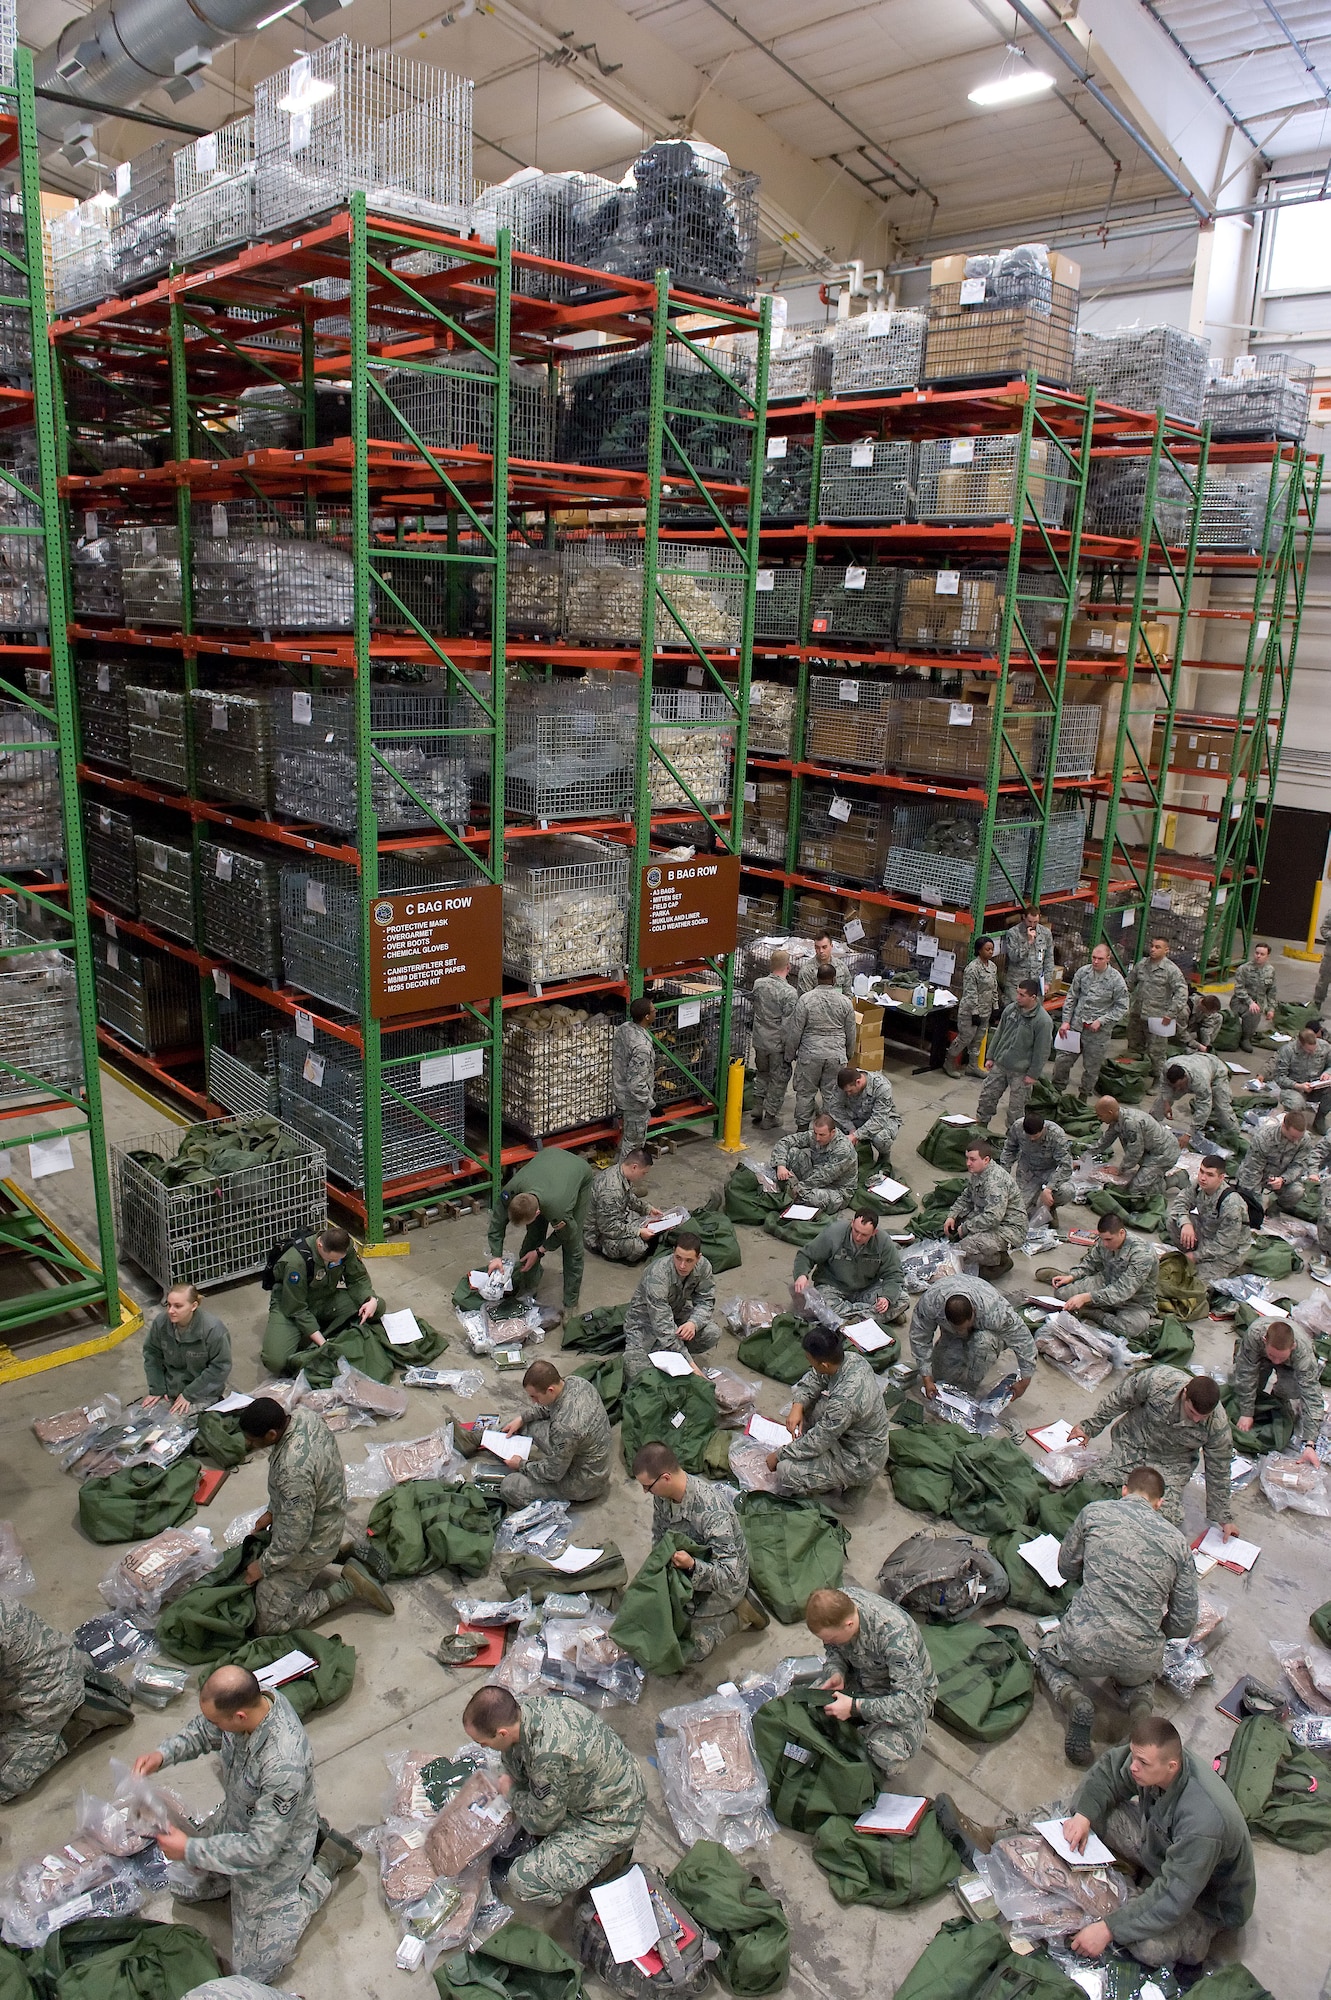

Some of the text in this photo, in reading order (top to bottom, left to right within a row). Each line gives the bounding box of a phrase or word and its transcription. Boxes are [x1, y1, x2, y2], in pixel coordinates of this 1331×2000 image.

[668, 866, 717, 880] B BAG ROW
[661, 887, 675, 895] BAGS
[653, 895, 671, 903] MITTEN
[406, 897, 472, 915] C BAG ROW
[652, 910, 670, 918] PARKA
[652, 917, 674, 925] MUKLUK
[686, 912, 700, 920] LINER
[387, 919, 448, 933] PROTECTIVE MASK
[667, 921, 691, 930] WEATHER
[692, 918, 709, 926] SOCKS
[387, 929, 433, 942] OVERGARMET
[387, 938, 430, 951] OVER BOOTS
[387, 944, 449, 959] CHEMICAL GLOVES
[387, 958, 458, 976] CANISTER/FILTER SET
[409, 970, 443, 981] DETECTOR
[445, 965, 466, 974] PAPER
[388, 977, 441, 993] M295 DECON KIT
